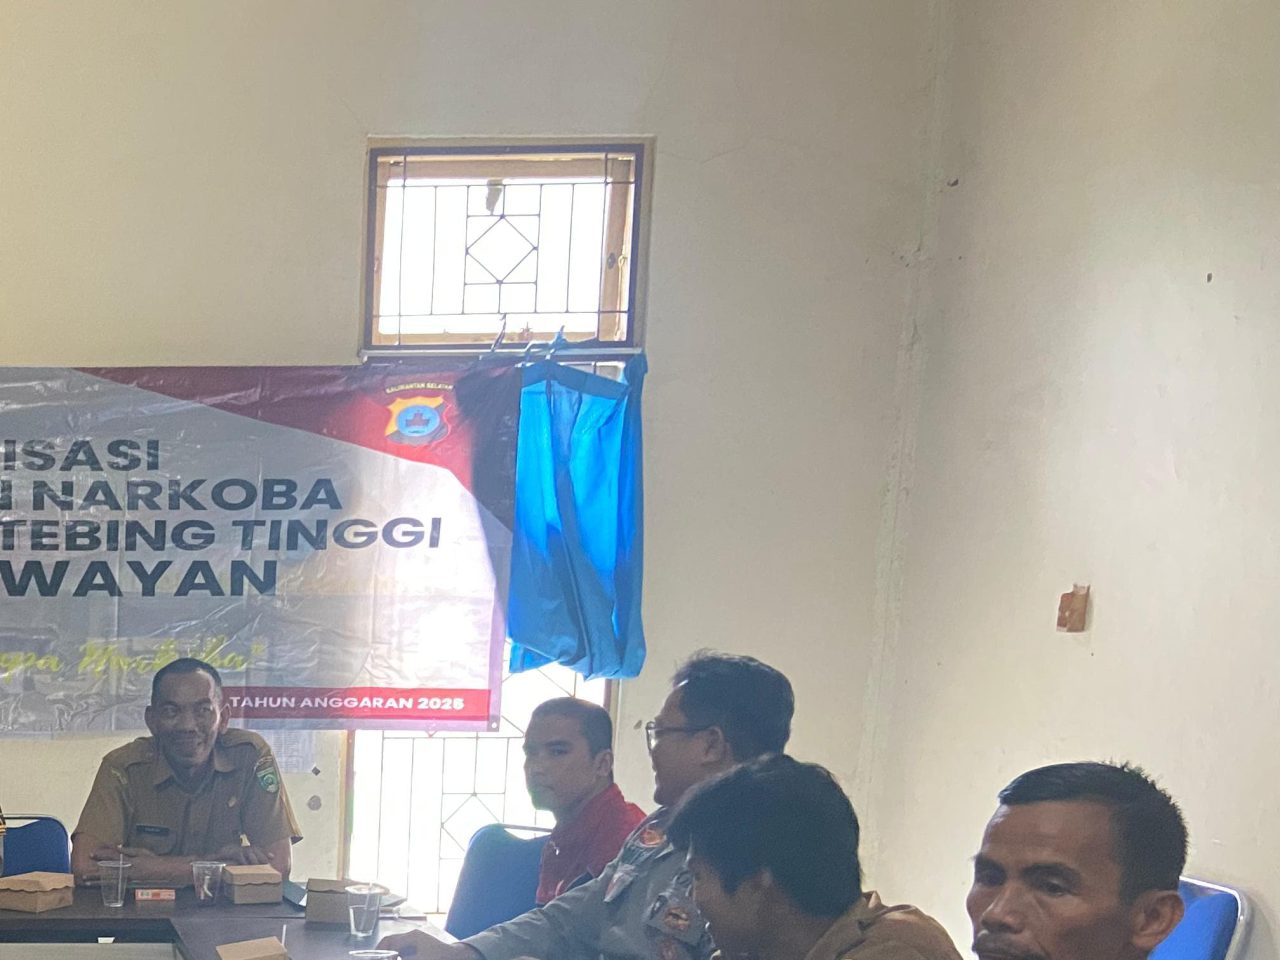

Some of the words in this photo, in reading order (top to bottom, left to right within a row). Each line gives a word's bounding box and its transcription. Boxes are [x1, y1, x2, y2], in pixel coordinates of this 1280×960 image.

[32, 478, 344, 512] NARKOBA
[233, 517, 442, 551] TINGGI
[230, 695, 296, 709] TAHUN
[299, 696, 414, 710] ANGGARAN
